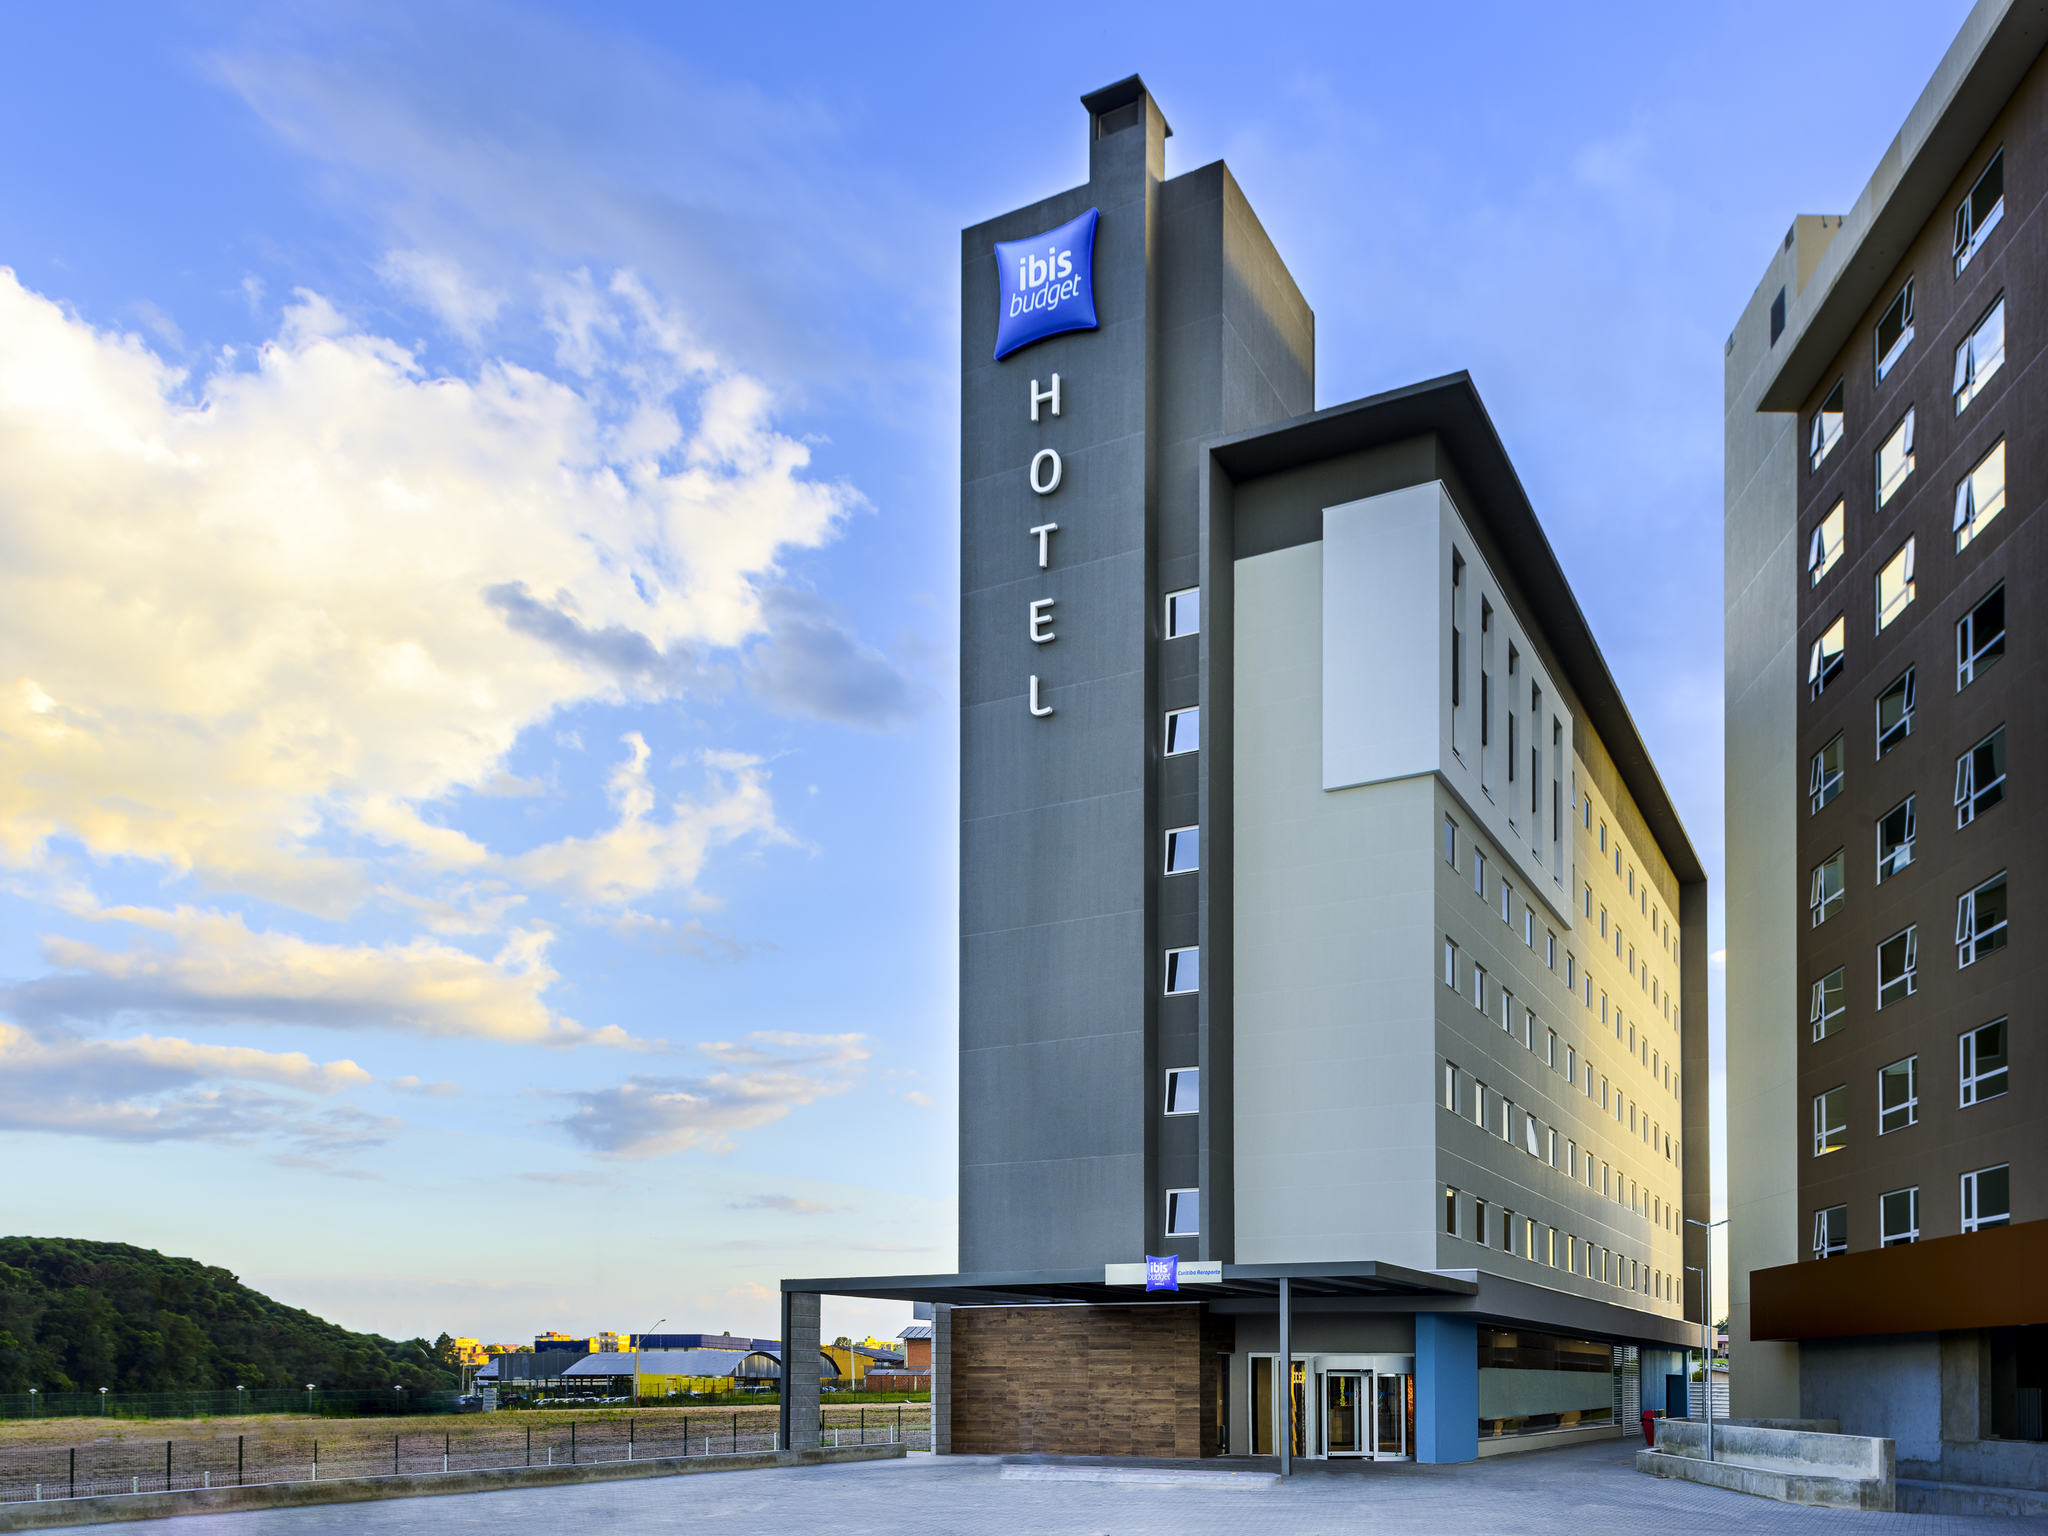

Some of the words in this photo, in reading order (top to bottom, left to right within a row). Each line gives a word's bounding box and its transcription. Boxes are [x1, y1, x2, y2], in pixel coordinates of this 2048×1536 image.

[1019, 246, 1073, 291] ibis
[1008, 273, 1081, 318] budget
[1030, 373, 1062, 717] HOTEL
[1148, 1273, 1171, 1282] budget
[1150, 1262, 1168, 1273] ibis
